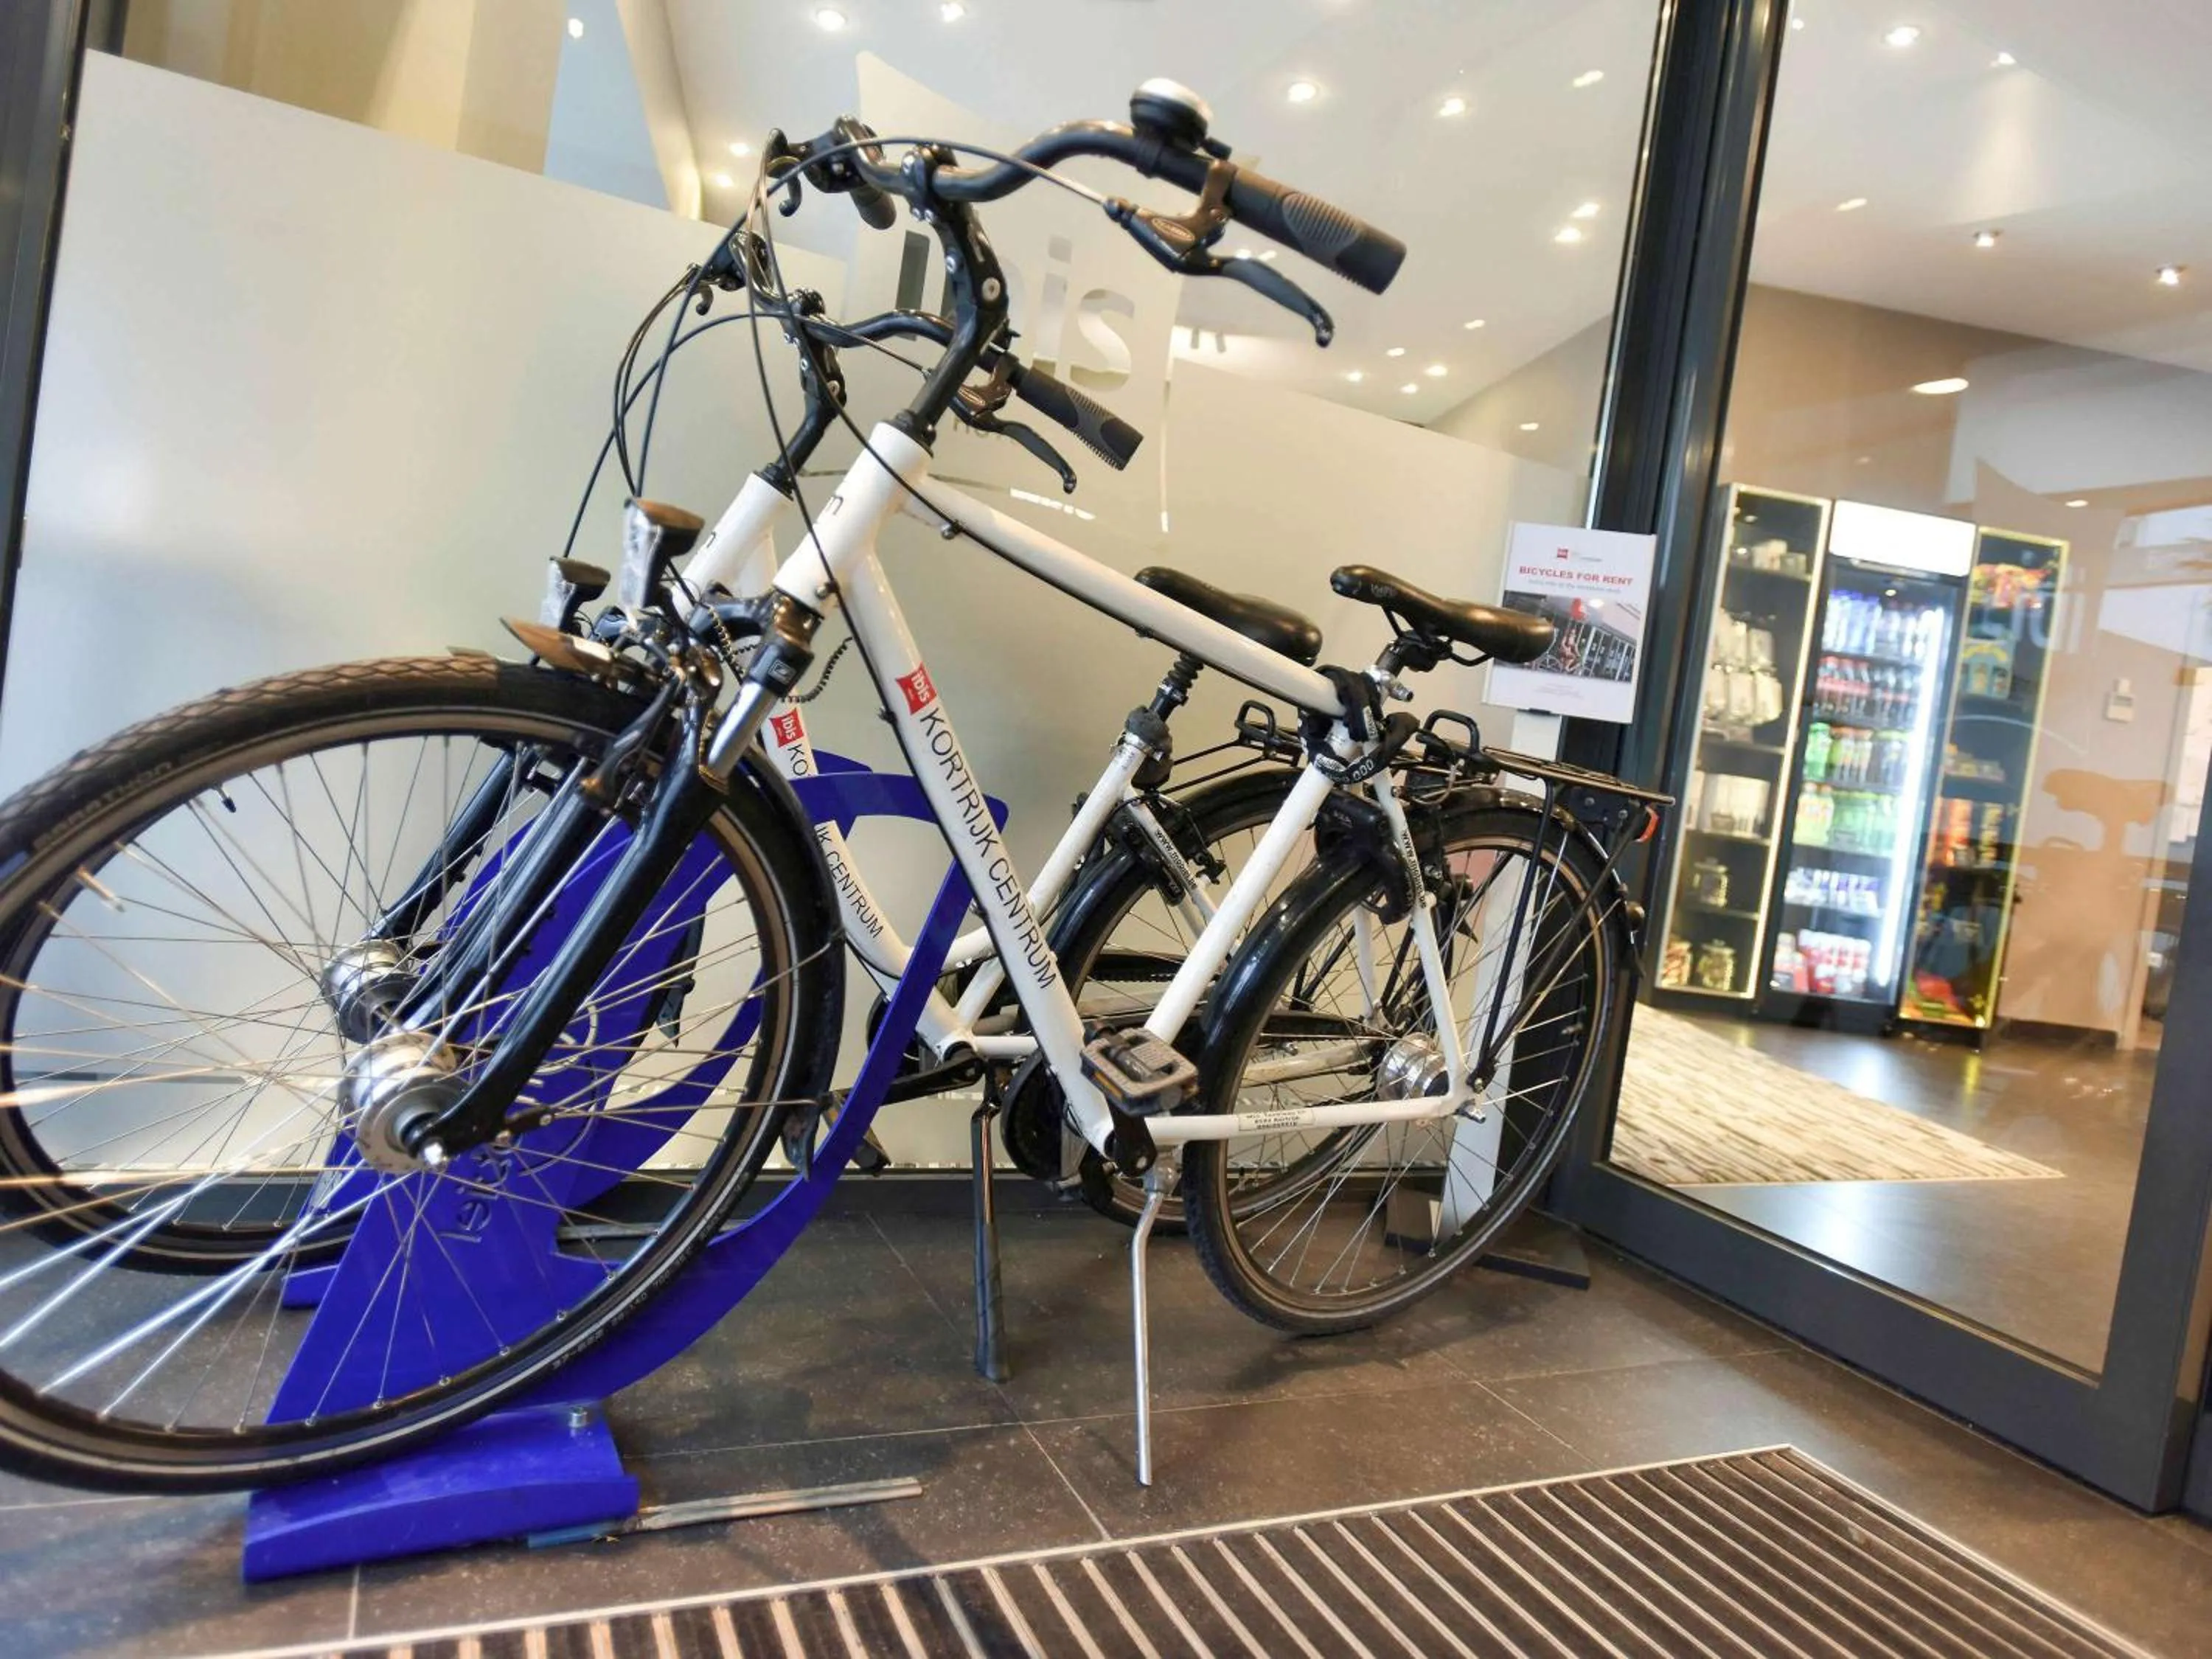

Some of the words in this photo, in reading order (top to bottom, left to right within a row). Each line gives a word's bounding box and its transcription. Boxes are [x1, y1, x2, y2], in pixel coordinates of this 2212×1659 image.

[1519, 566, 1574, 580] BICYCLES
[1576, 572, 1600, 583] FOR
[1602, 576, 1634, 587] RENT
[911, 669, 931, 703] ibis
[781, 714, 798, 740] ibis
[825, 850, 884, 940] CENTRUM
[919, 706, 998, 857] KORTRIJK
[989, 857, 1057, 990] CENTRUM
